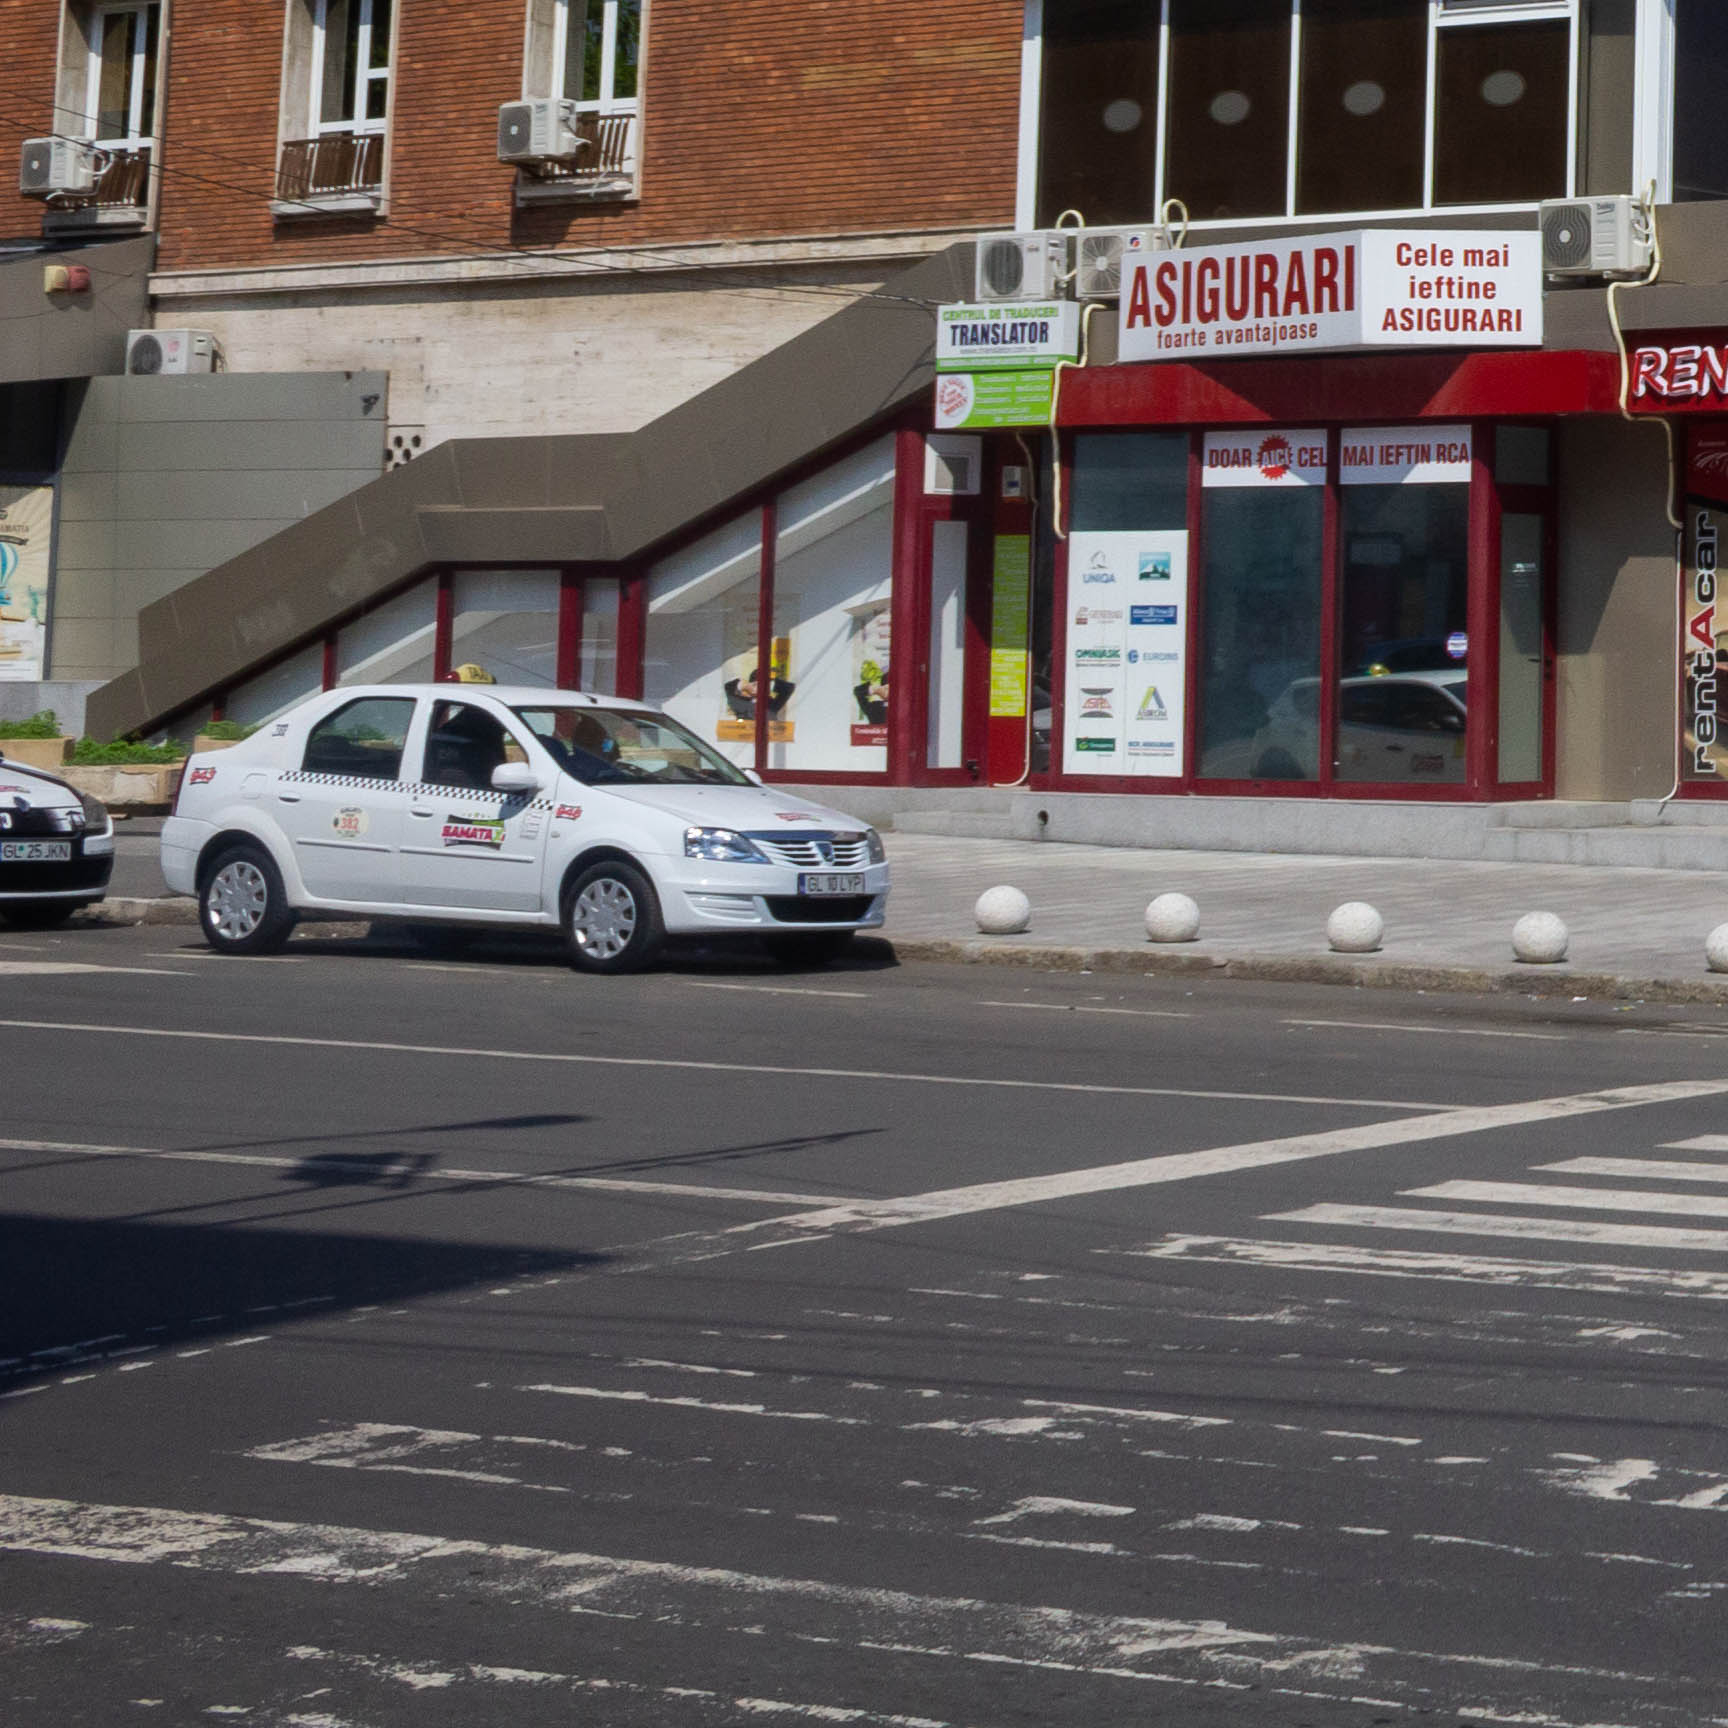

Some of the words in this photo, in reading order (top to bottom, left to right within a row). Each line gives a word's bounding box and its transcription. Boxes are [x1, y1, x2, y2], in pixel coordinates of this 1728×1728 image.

[1396, 242, 1454, 267] Cele
[1463, 243, 1510, 267] mai
[1126, 245, 1355, 330] ASIGURARI
[1408, 275, 1497, 299] ieftine
[1381, 308, 1523, 332] ASIGURARI
[950, 321, 1049, 346] TRANSLATOR
[1157, 328, 1206, 350] foarte
[1215, 321, 1318, 347] avantajoase
[1208, 447, 1251, 468] DOAR
[1297, 446, 1327, 468] CEL
[1342, 445, 1374, 466] MAI
[1379, 443, 1430, 466] IEFTIN
[1436, 442, 1470, 464] RCA
